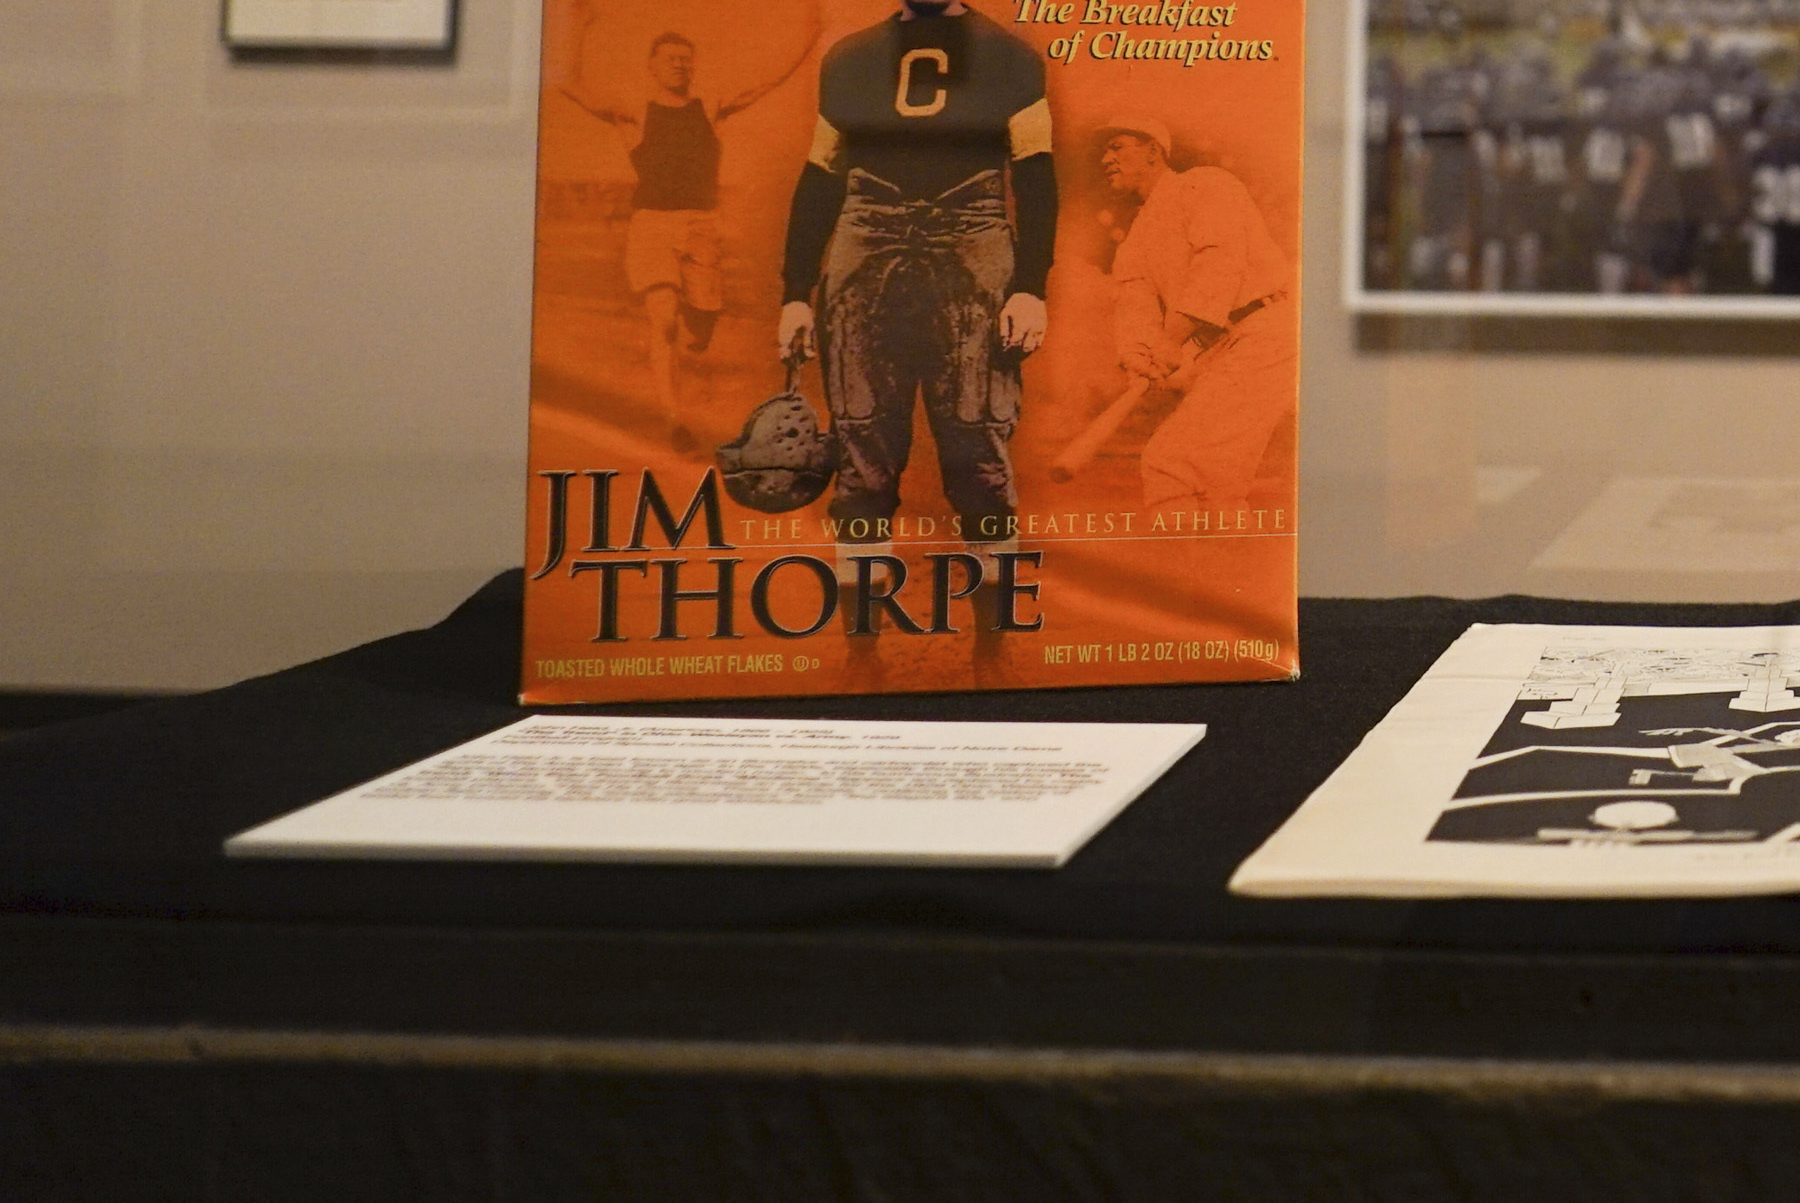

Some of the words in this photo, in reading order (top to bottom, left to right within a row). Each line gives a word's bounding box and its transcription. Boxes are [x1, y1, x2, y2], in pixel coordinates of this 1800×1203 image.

[1048, 30, 1085, 65] of
[895, 48, 948, 117] C
[531, 467, 736, 581] JIM
[740, 518, 802, 540] THE
[821, 515, 962, 539] WORLD'S
[980, 512, 1136, 536] GREATEST
[1151, 509, 1287, 533] ATHLETE
[568, 549, 1047, 644] THORPE
[536, 658, 604, 678] TOASTED
[609, 657, 665, 677] WHOLE
[669, 655, 724, 675] WHEAT
[727, 654, 784, 673] FLAKES
[1043, 645, 1073, 664] NET
[1077, 644, 1102, 663] WT
[1105, 644, 1114, 663] 1
[1118, 643, 1138, 662] LB
[1141, 642, 1151, 661] 2
[1154, 642, 1175, 660] OZ
[1178, 640, 1201, 664] (18
[1204, 640, 1230, 663] OZ)
